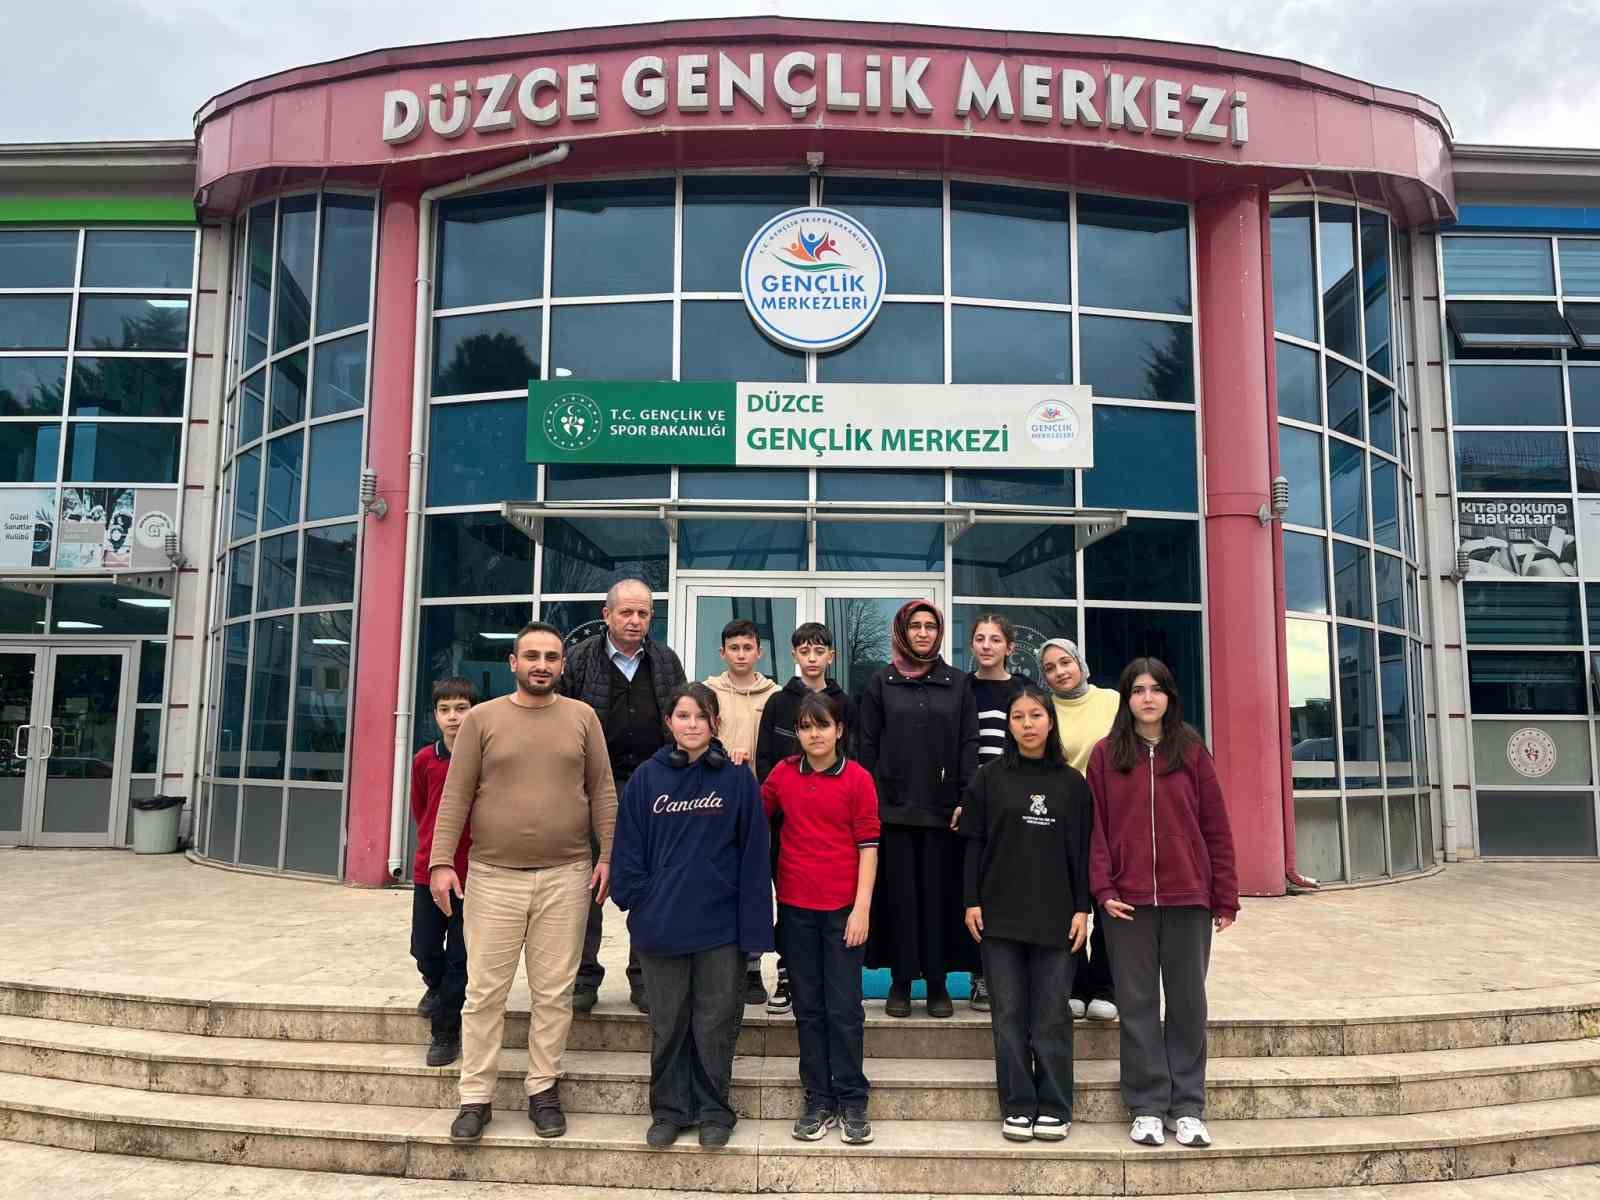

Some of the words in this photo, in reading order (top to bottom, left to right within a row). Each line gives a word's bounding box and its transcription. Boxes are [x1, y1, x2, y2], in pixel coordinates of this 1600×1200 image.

[382, 63, 600, 145] DÜZCE
[621, 51, 935, 119] GENÇLİK
[954, 57, 1249, 147] MERKEZİ
[761, 273, 865, 294] GENÇLİK
[761, 295, 868, 310] MERKEZLERİ
[747, 390, 824, 413] DÜZCE
[610, 408, 636, 421] T.C.
[640, 408, 702, 425] GENÇLİK
[707, 409, 726, 421] VE
[610, 424, 647, 437] SPOR
[650, 422, 726, 437] BAKANLIĞI
[746, 422, 873, 457] GENÇLİK
[881, 424, 1009, 453] MERKEZİ
[652, 791, 724, 814] Canada
